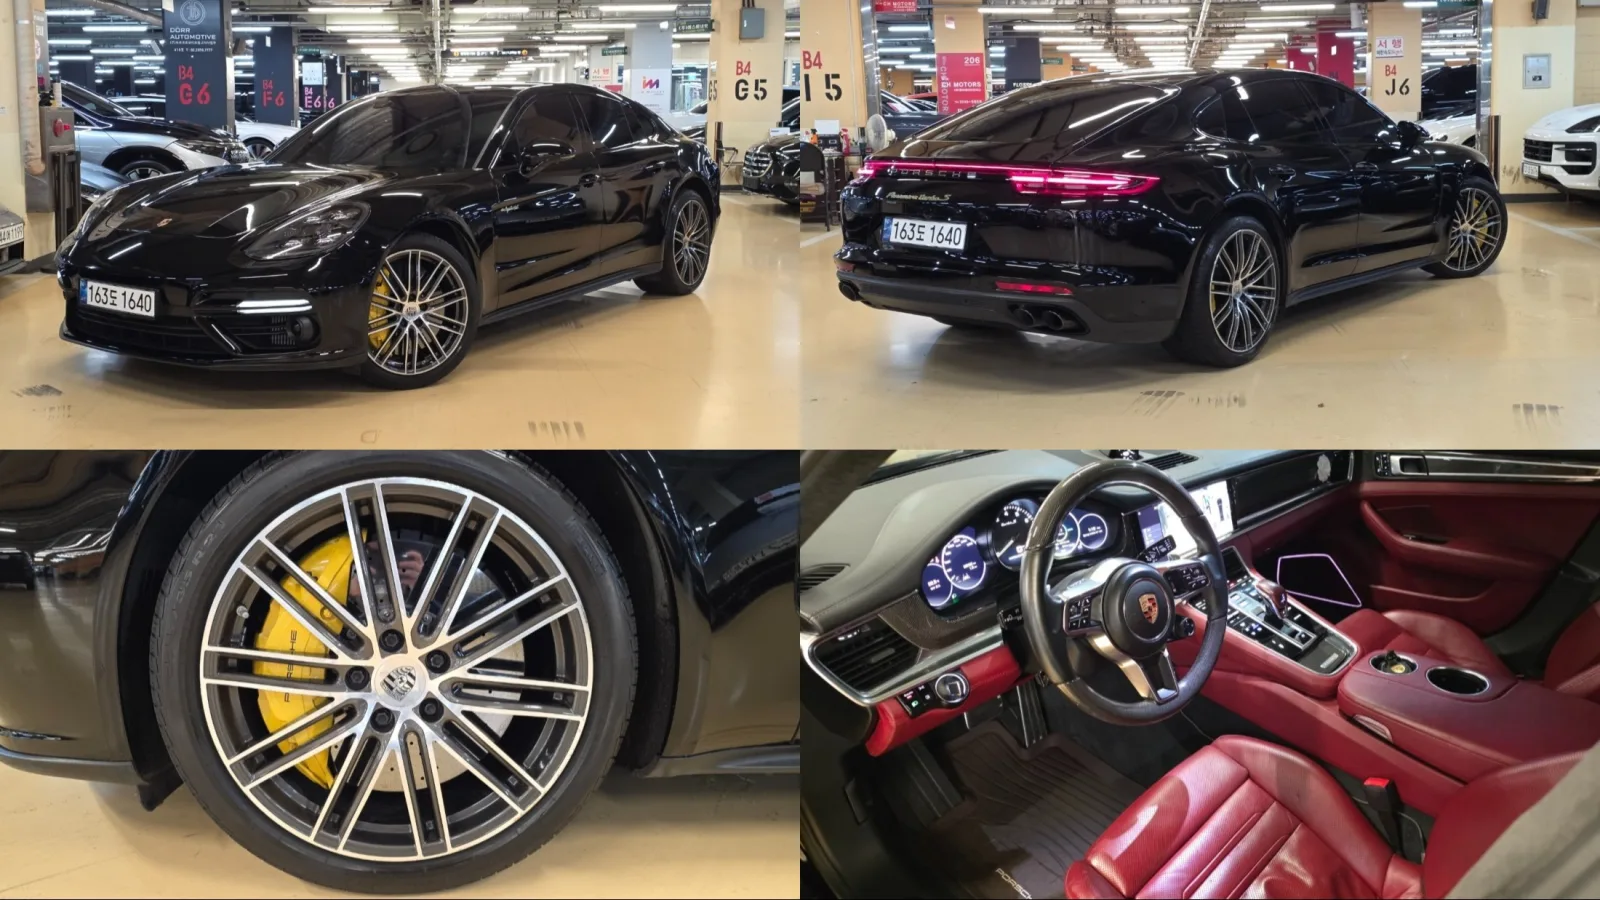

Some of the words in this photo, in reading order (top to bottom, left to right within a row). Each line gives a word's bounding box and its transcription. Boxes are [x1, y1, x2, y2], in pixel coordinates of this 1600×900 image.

[802, 50, 823, 70] B4
[963, 56, 981, 64] 206
[178, 65, 194, 80] B4
[735, 60, 752, 76] B4
[1385, 64, 1397, 77] B4
[262, 80, 274, 90] B4
[304, 87, 313, 95] B4
[888, 168, 977, 179] PORSCHE
[893, 221, 926, 242] 163도
[929, 224, 962, 246] 1640
[88, 284, 118, 307] 163도
[121, 290, 152, 313] 1640
